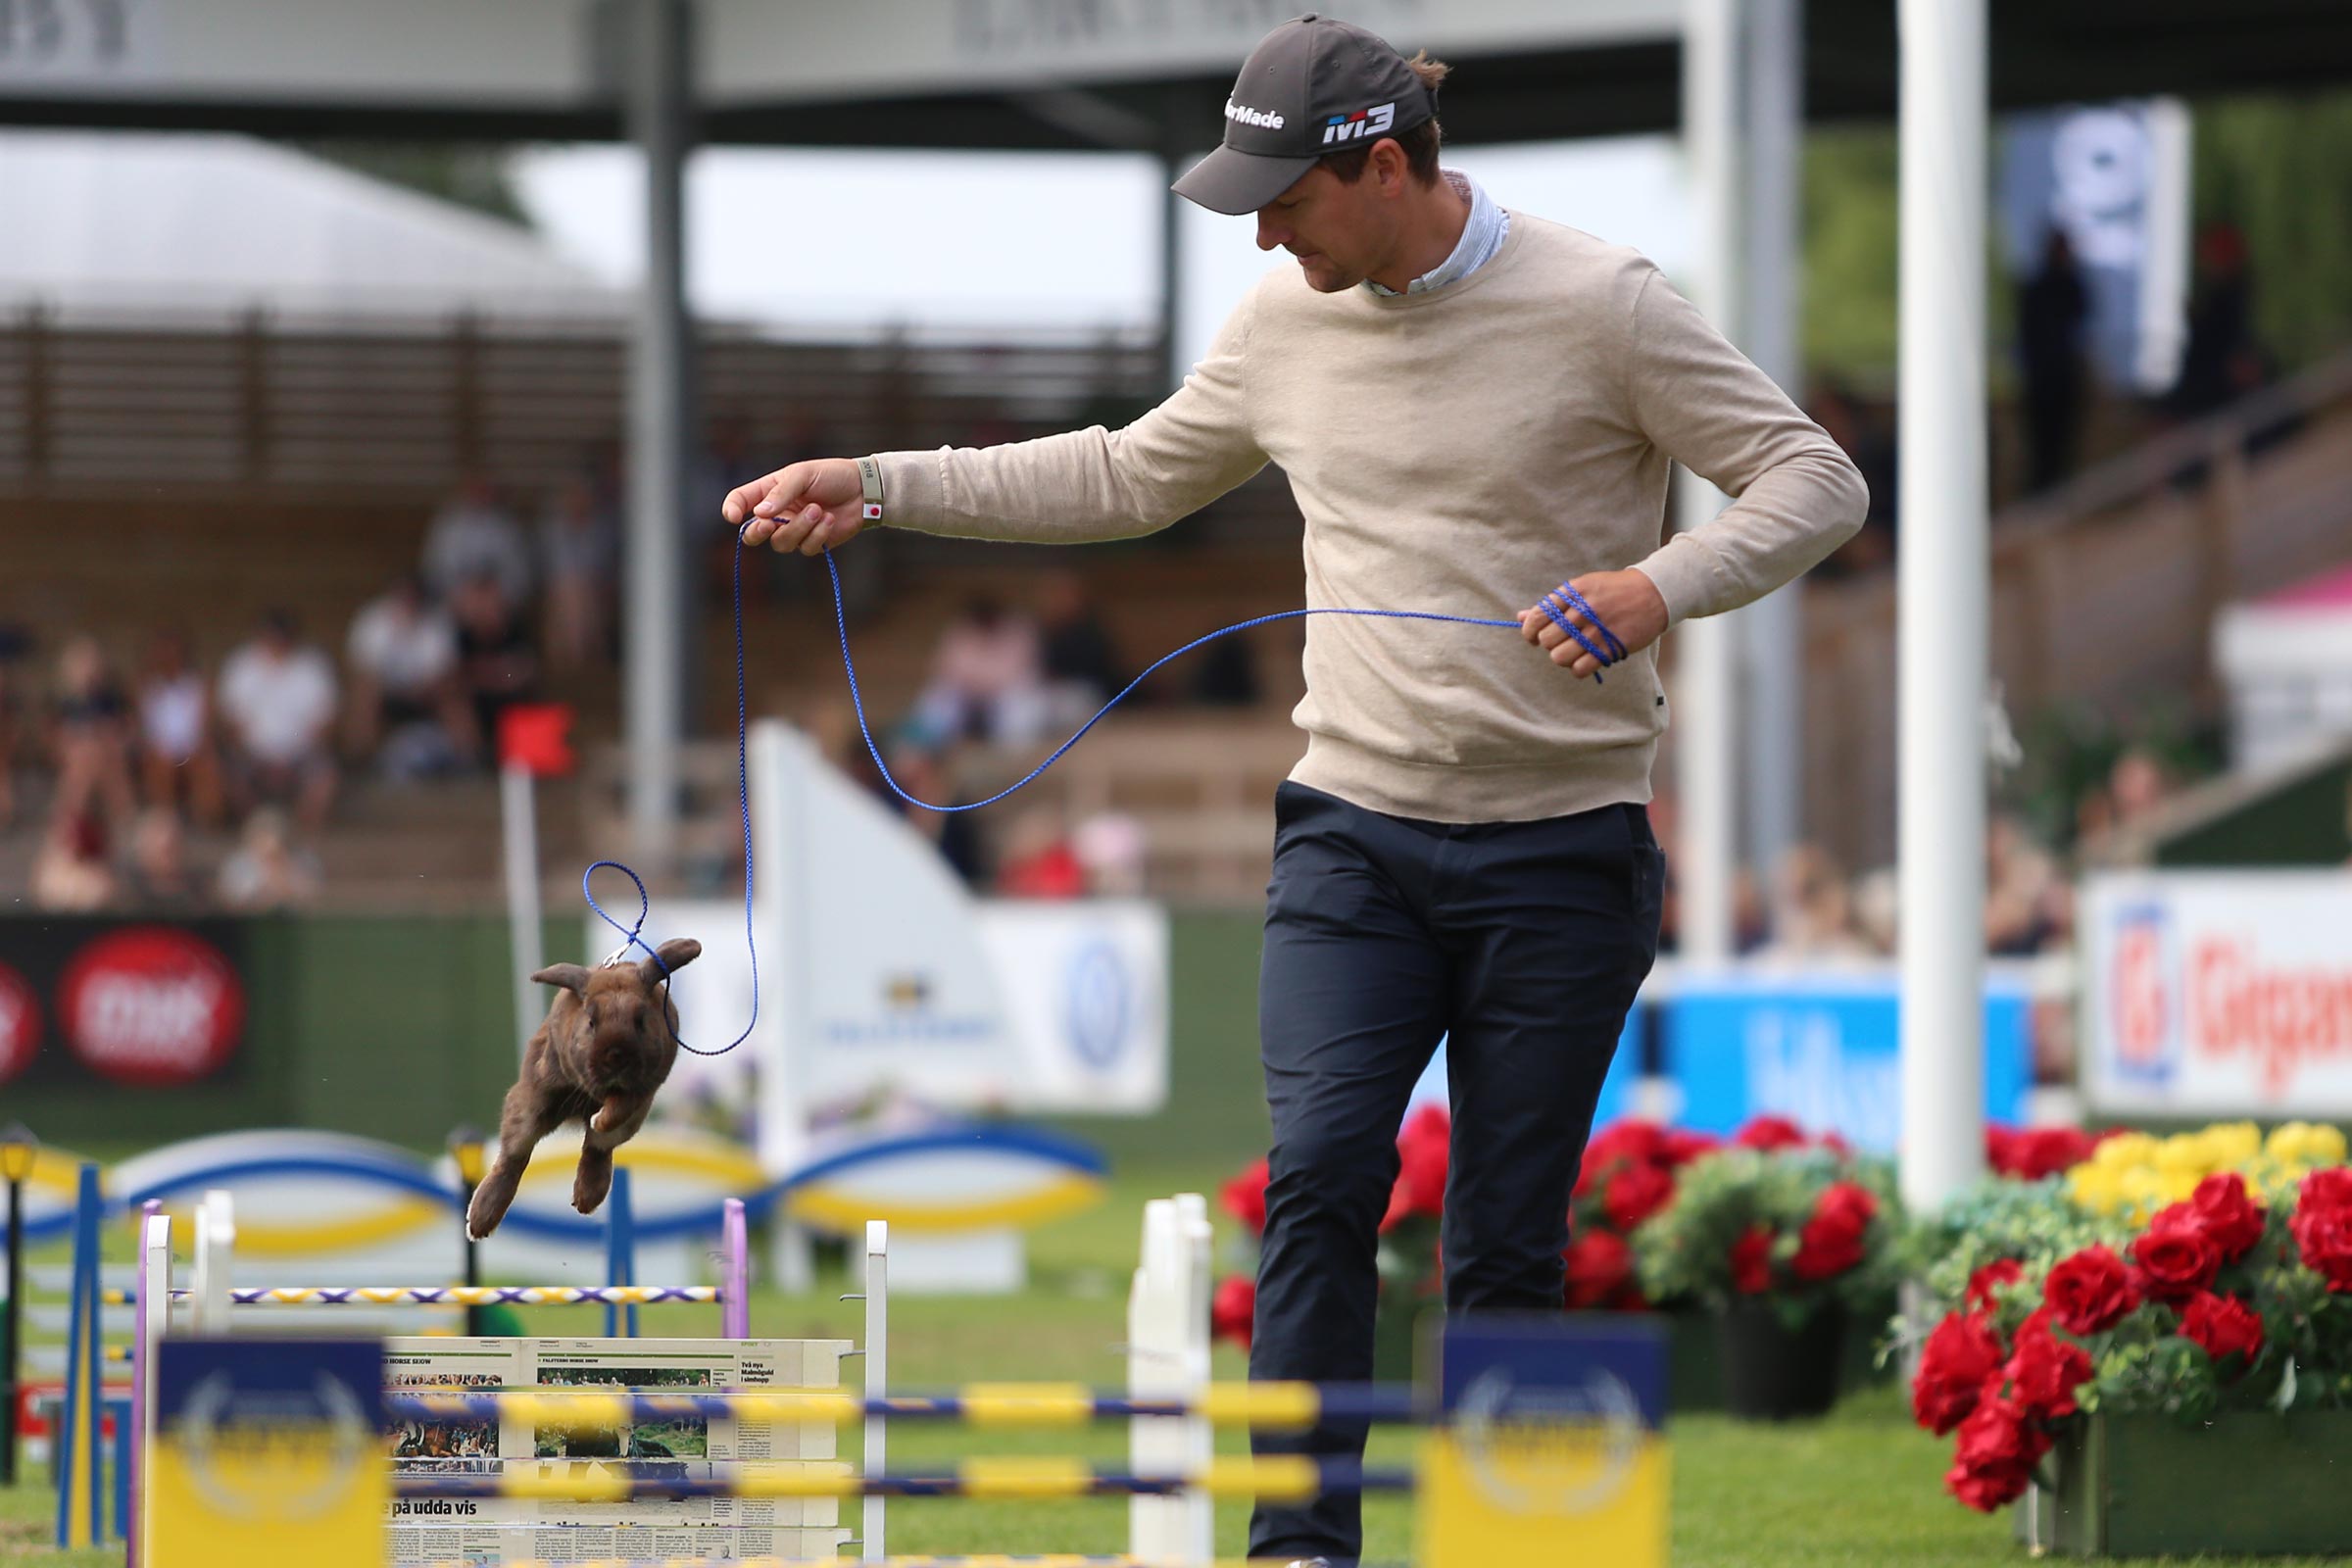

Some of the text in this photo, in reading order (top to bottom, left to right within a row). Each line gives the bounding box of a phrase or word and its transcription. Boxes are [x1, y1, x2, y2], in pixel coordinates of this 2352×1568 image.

[392, 1497, 411, 1518] på
[414, 1499, 452, 1515] udda
[455, 1500, 477, 1515] vis
